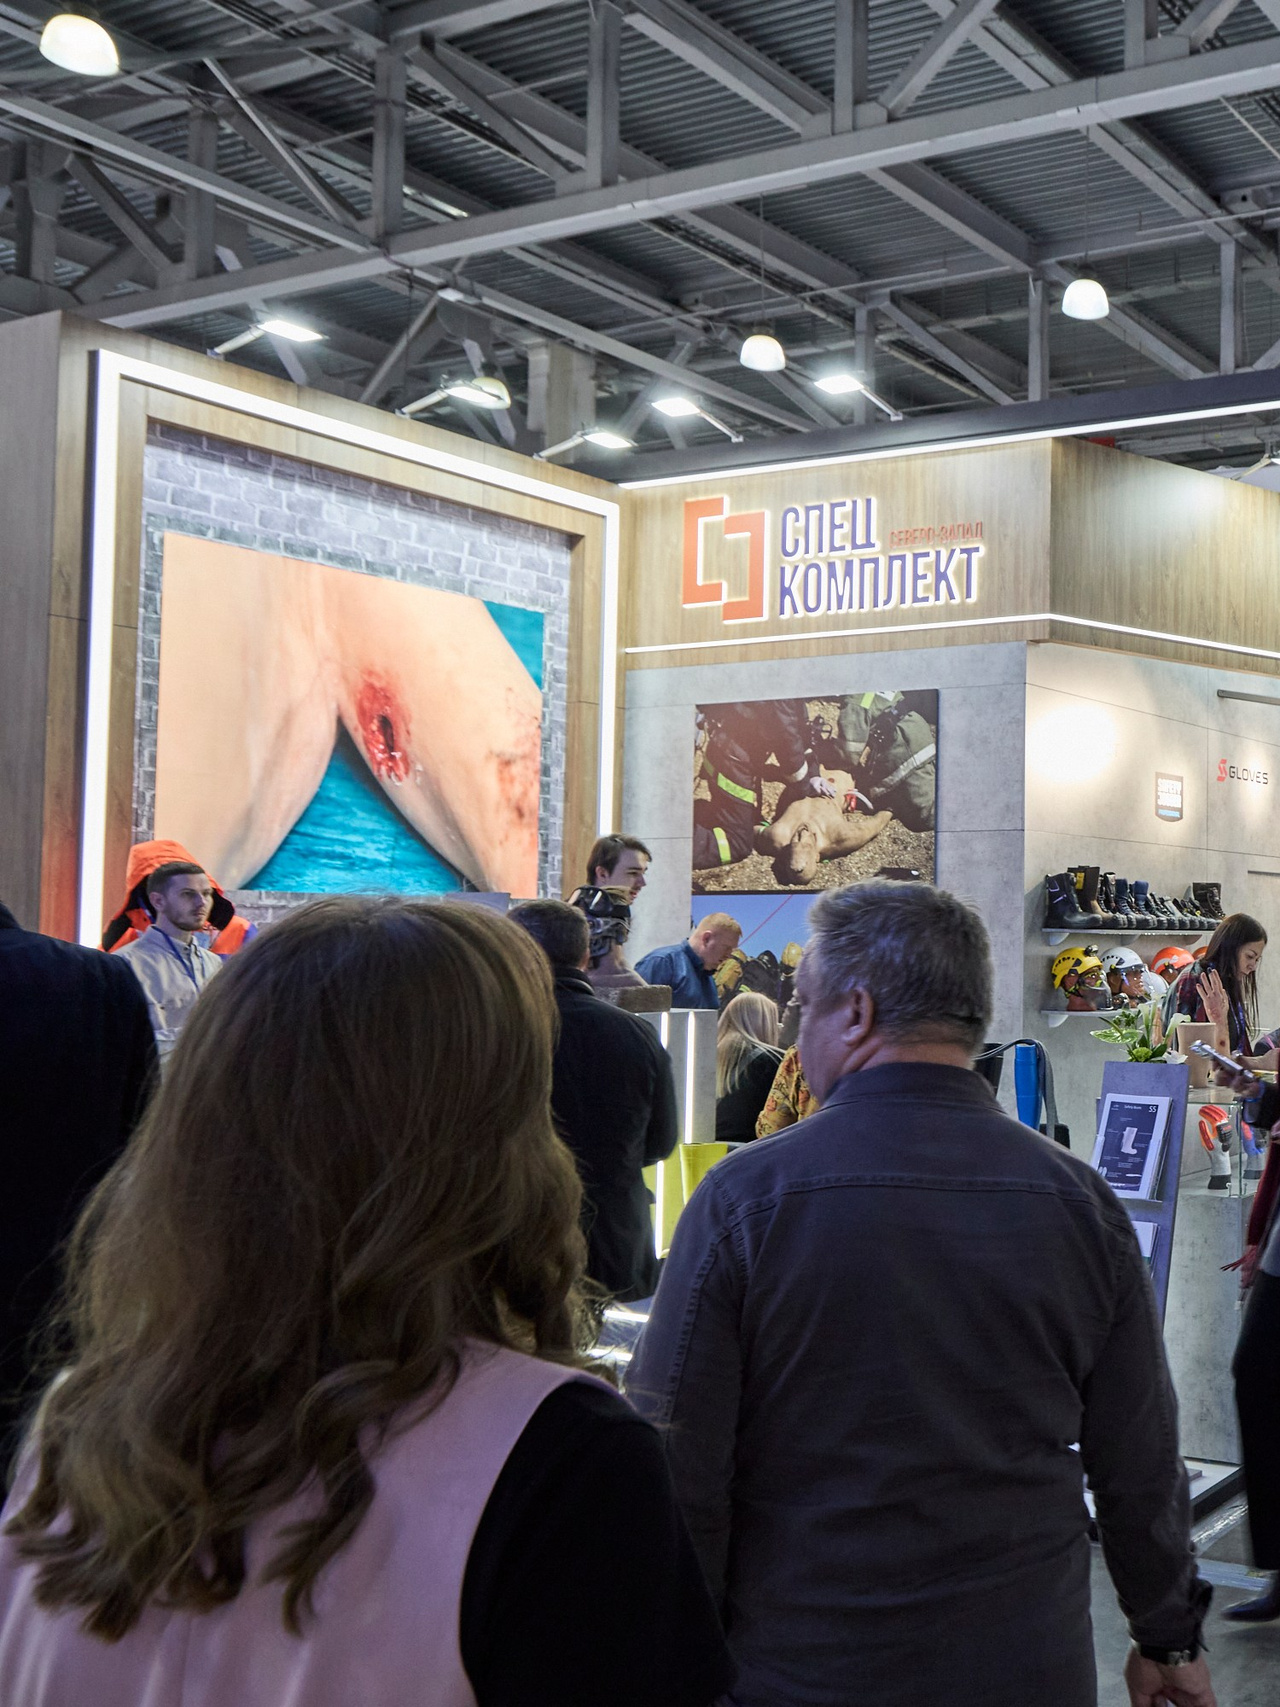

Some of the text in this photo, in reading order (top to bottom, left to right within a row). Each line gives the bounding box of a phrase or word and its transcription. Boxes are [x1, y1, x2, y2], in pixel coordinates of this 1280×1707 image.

[781, 497, 877, 560] СПЕЦ
[887, 521, 984, 548] СЕВЕРО-ЗАПАД
[779, 547, 982, 617] КОМПЛЕКТ
[1228, 765, 1269, 785] GLOVES
